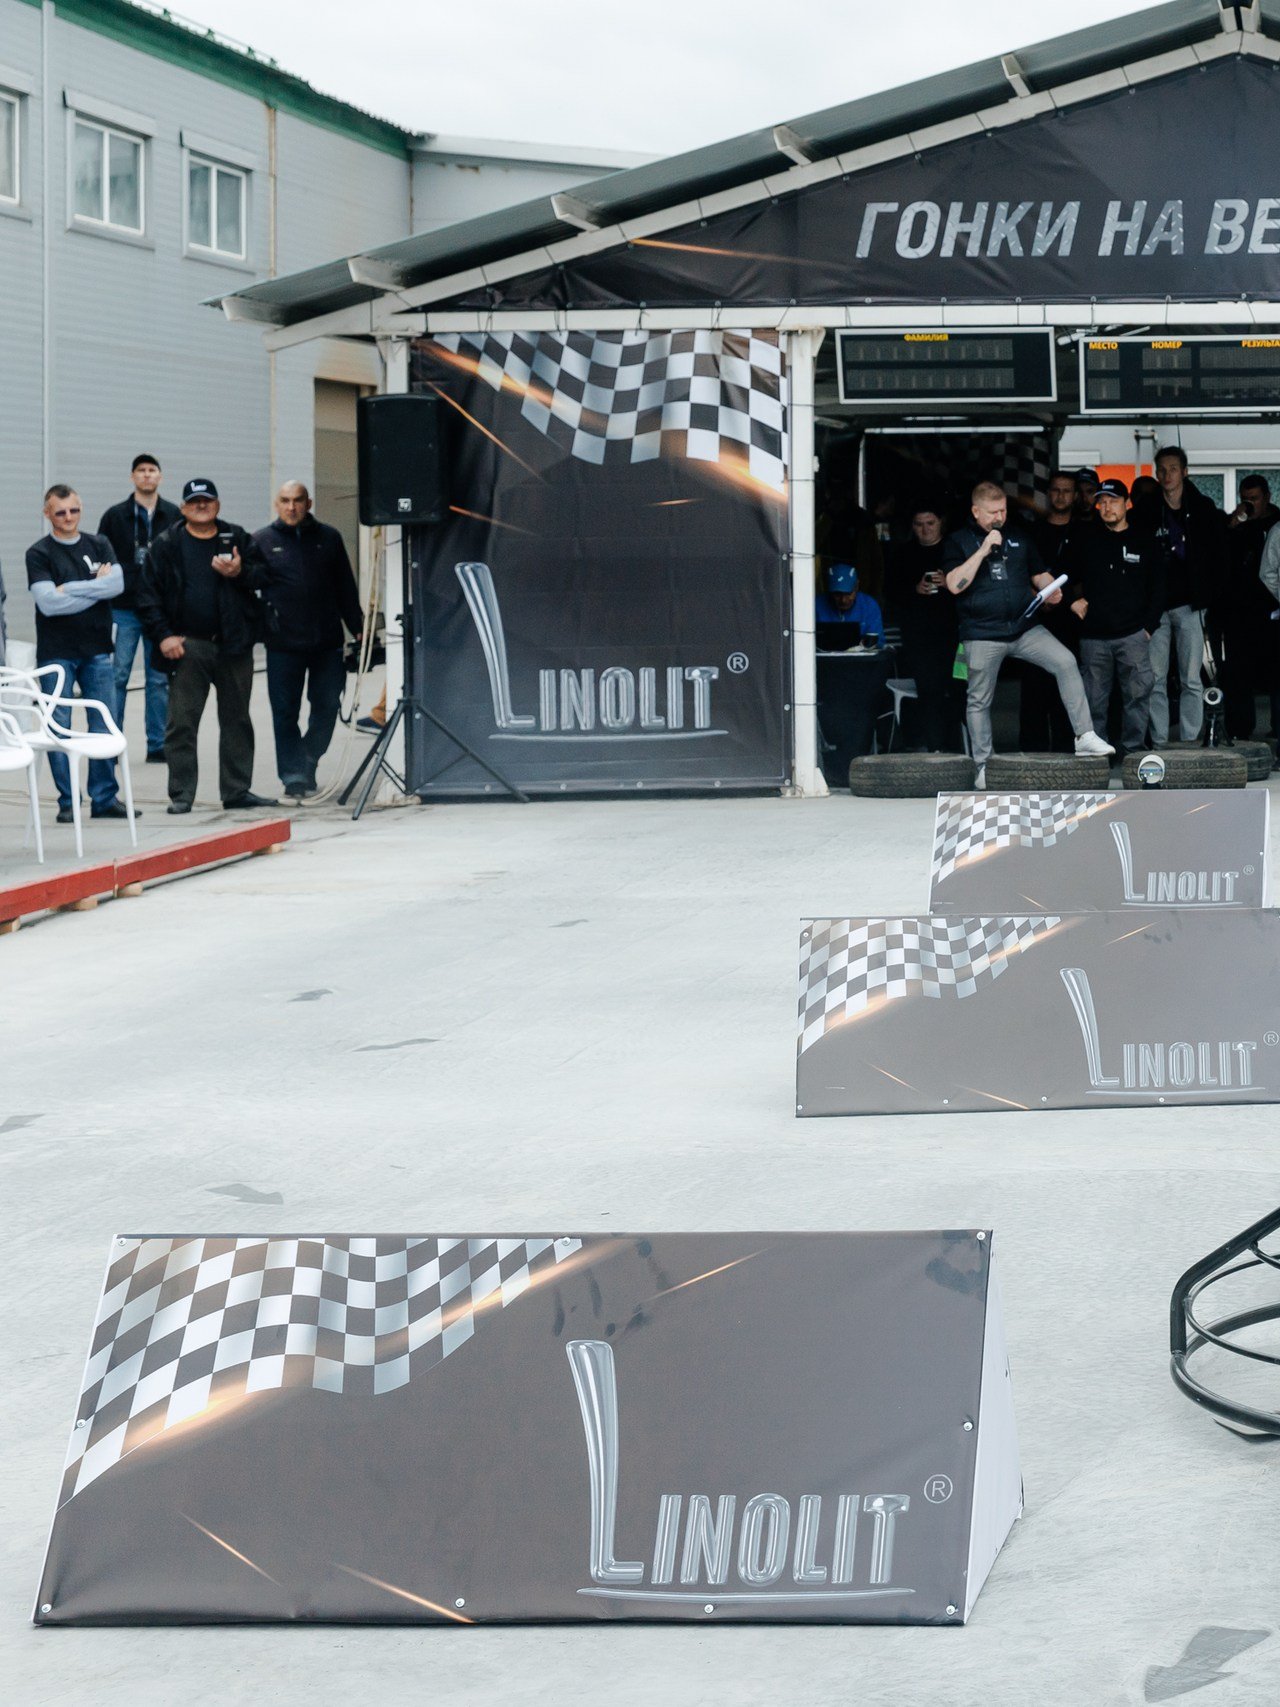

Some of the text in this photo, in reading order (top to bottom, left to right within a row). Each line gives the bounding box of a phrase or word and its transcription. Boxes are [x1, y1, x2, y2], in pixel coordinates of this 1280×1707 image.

[855, 200, 1081, 258] ГОНКИ
[1098, 199, 1185, 257] НА
[904, 333, 949, 342] ФАМИЛИЯ
[1089, 341, 1118, 350] МЕСТО
[1151, 340, 1182, 349] НОМЕР
[455, 561, 719, 731] LINOLIT
[1109, 821, 1239, 902] LINOLIT
[1059, 967, 1258, 1088] LINOLIT
[566, 1339, 911, 1586] LINOLIT
